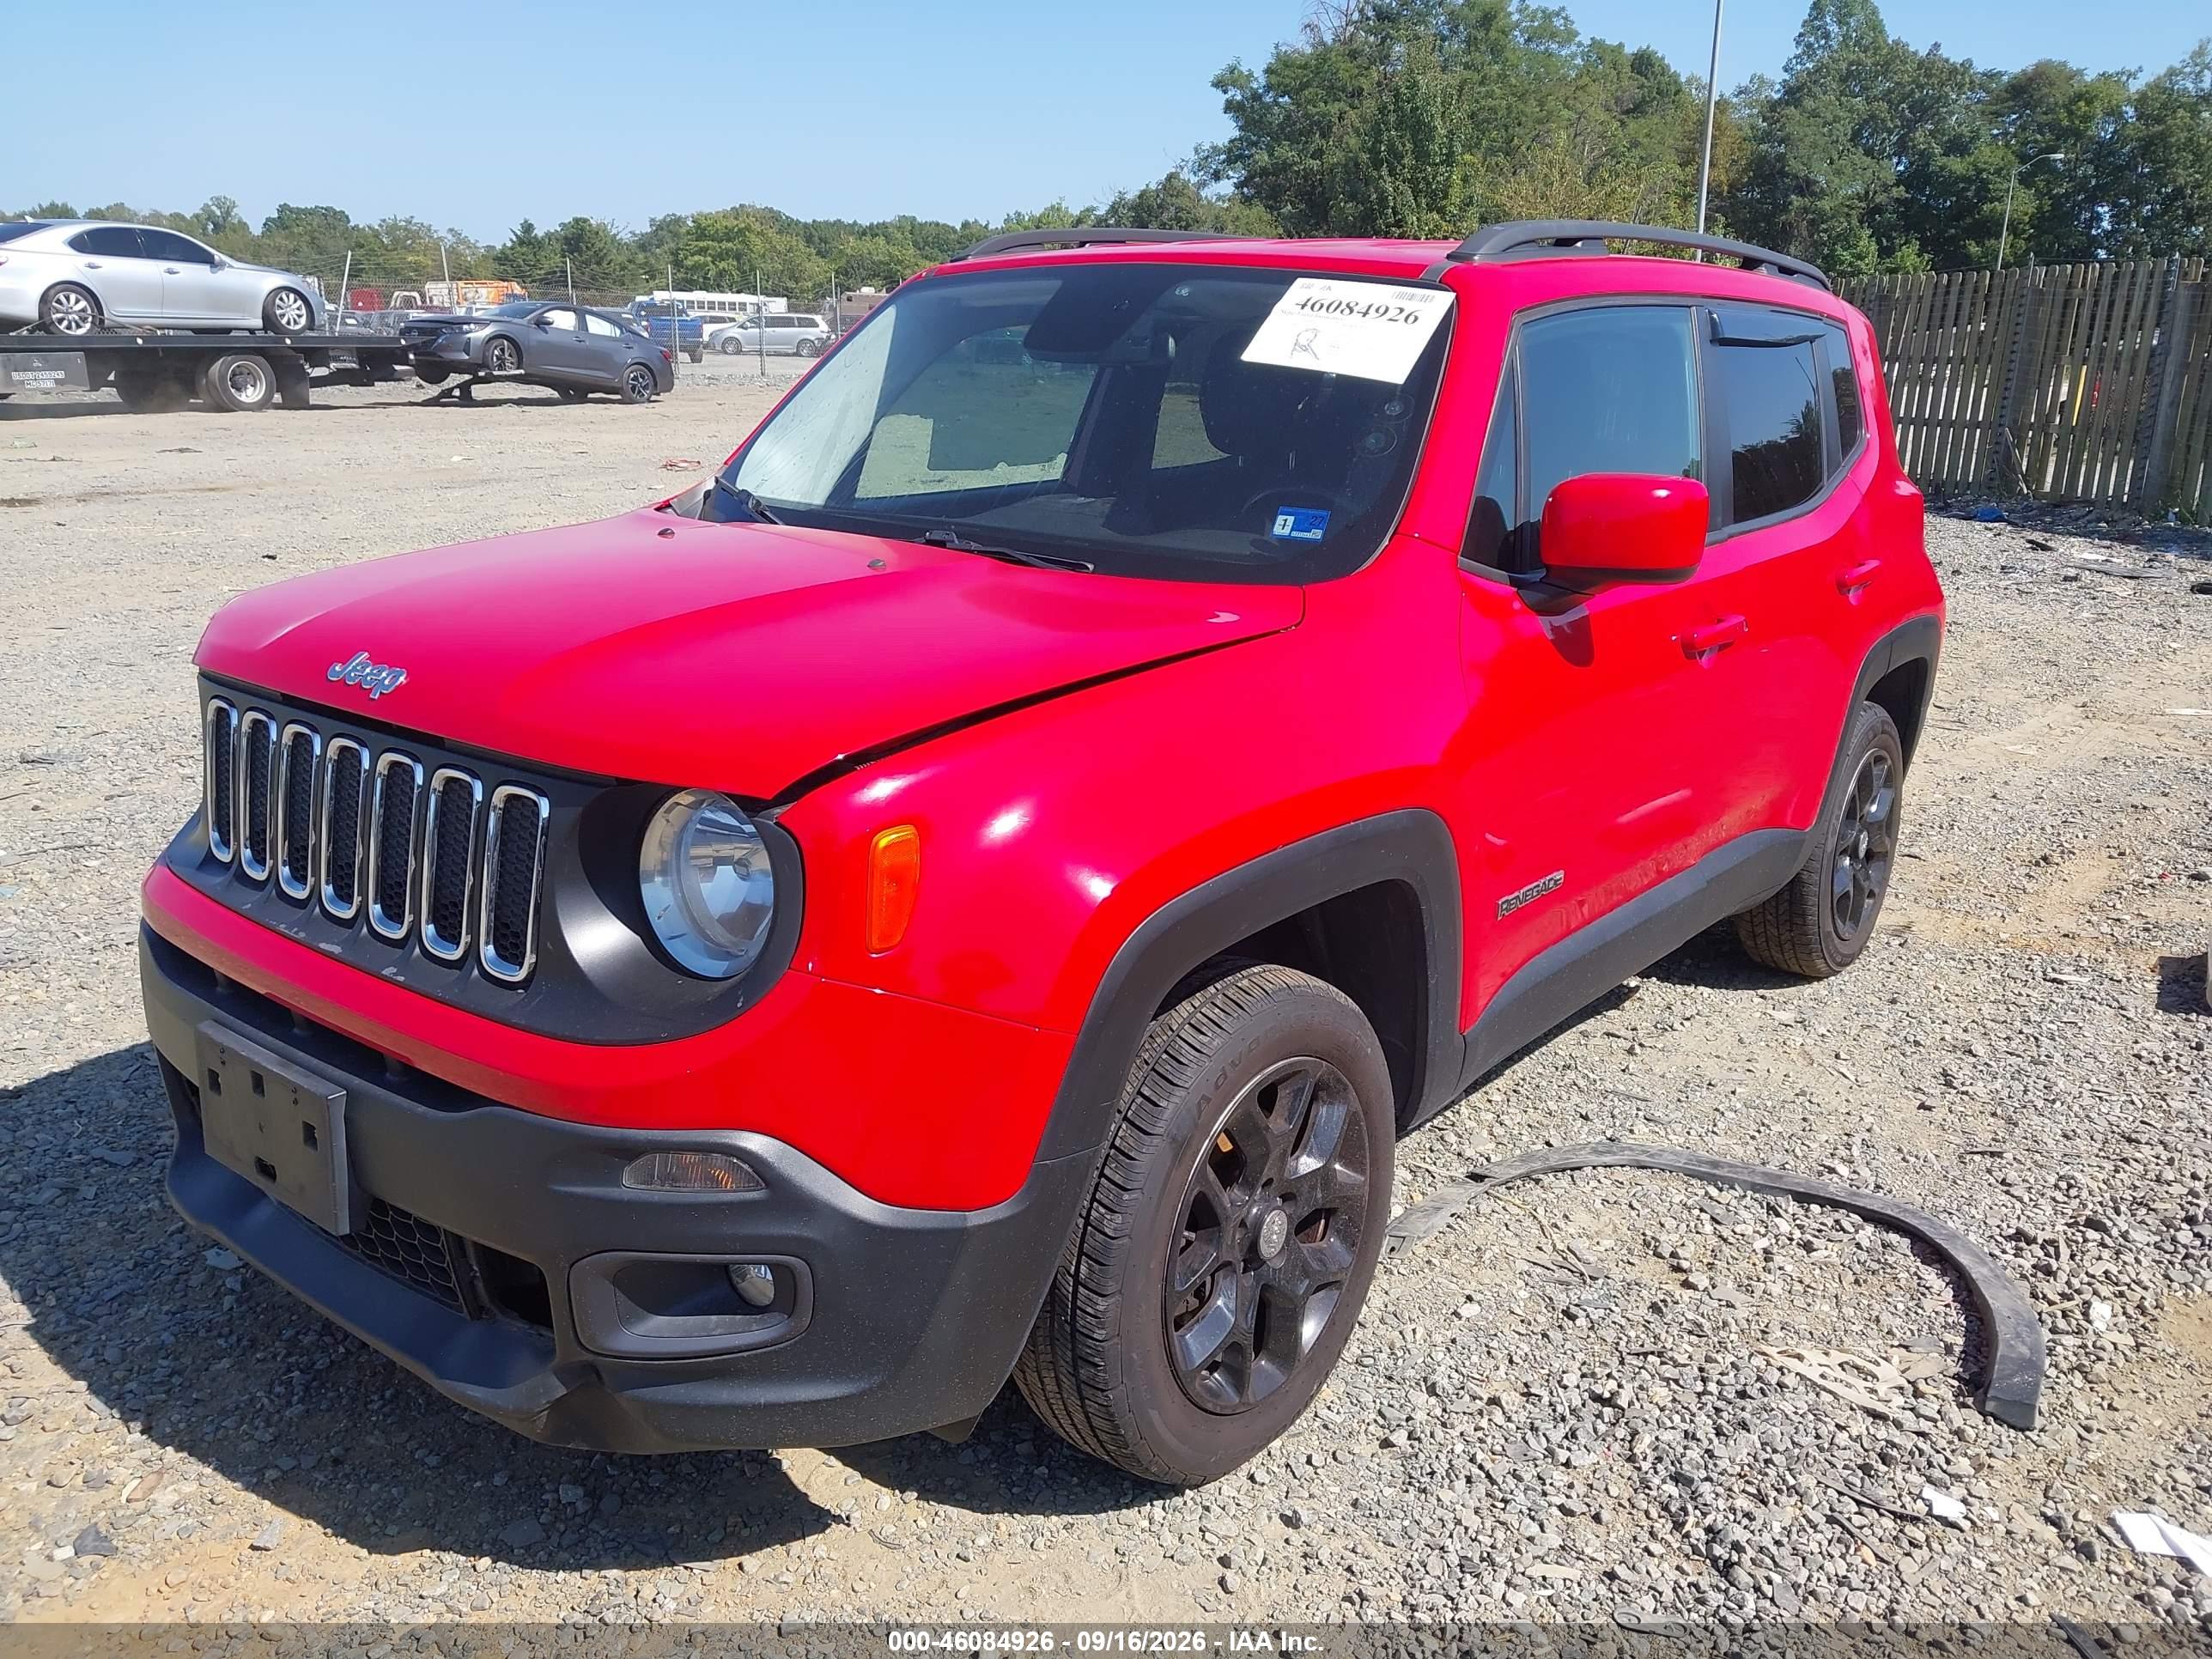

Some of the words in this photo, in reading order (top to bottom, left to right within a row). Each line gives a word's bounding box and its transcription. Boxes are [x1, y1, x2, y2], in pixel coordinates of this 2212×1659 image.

[1295, 295, 1422, 325] 46084926
[12, 371, 34, 380] USDOT
[327, 651, 407, 700] Jeep
[1497, 870, 1565, 921] RENEGADE
